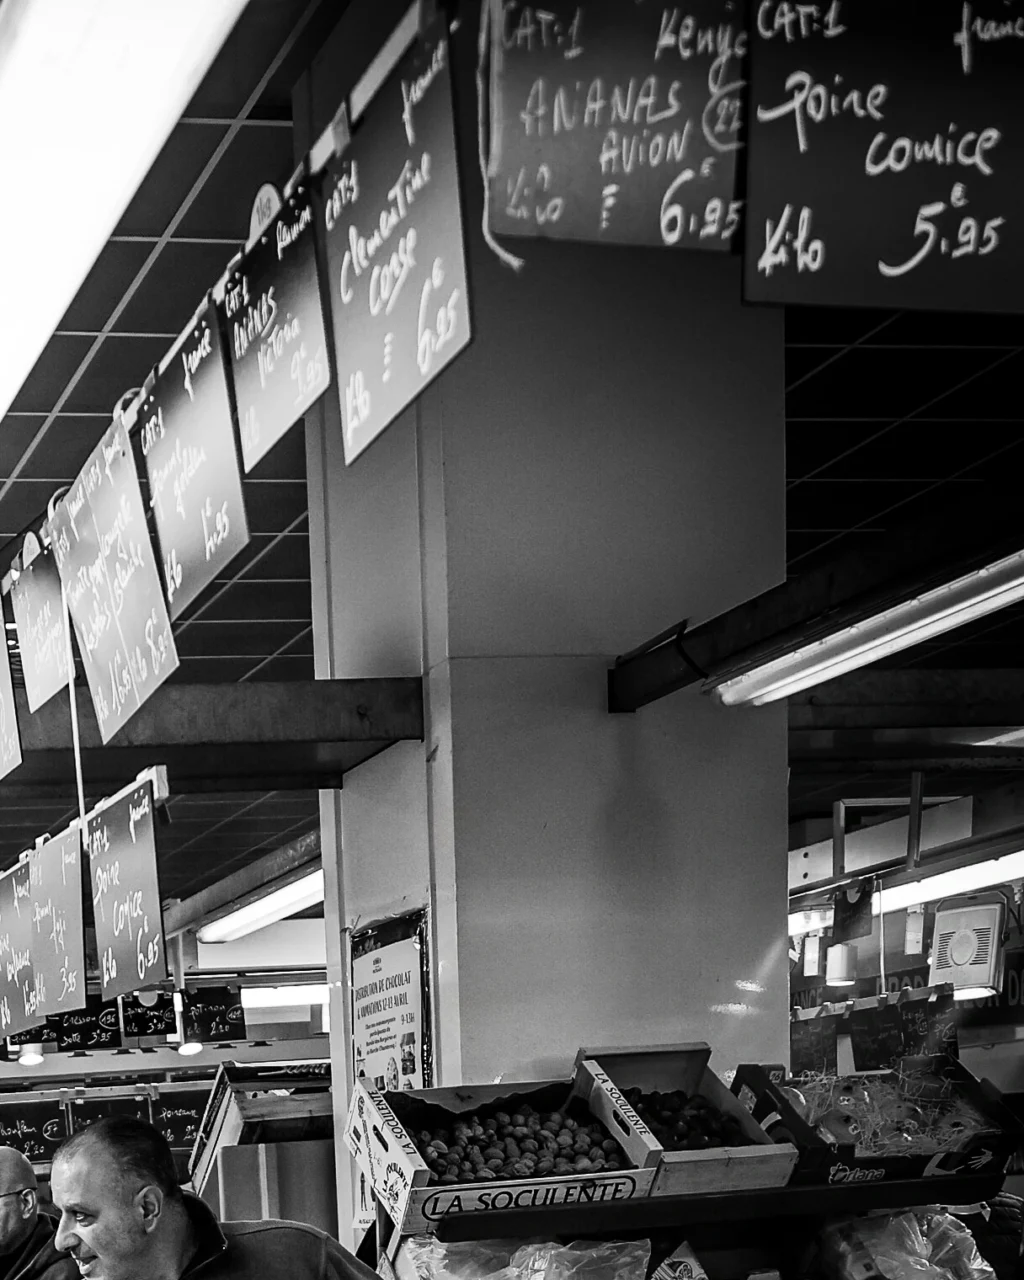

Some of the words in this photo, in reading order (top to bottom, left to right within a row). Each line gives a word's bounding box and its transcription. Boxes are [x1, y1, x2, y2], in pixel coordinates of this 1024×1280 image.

[519, 76, 682, 136] ANANAS
[429, 1195, 464, 1216] LA
[475, 1181, 628, 1211] SOCULENTE
